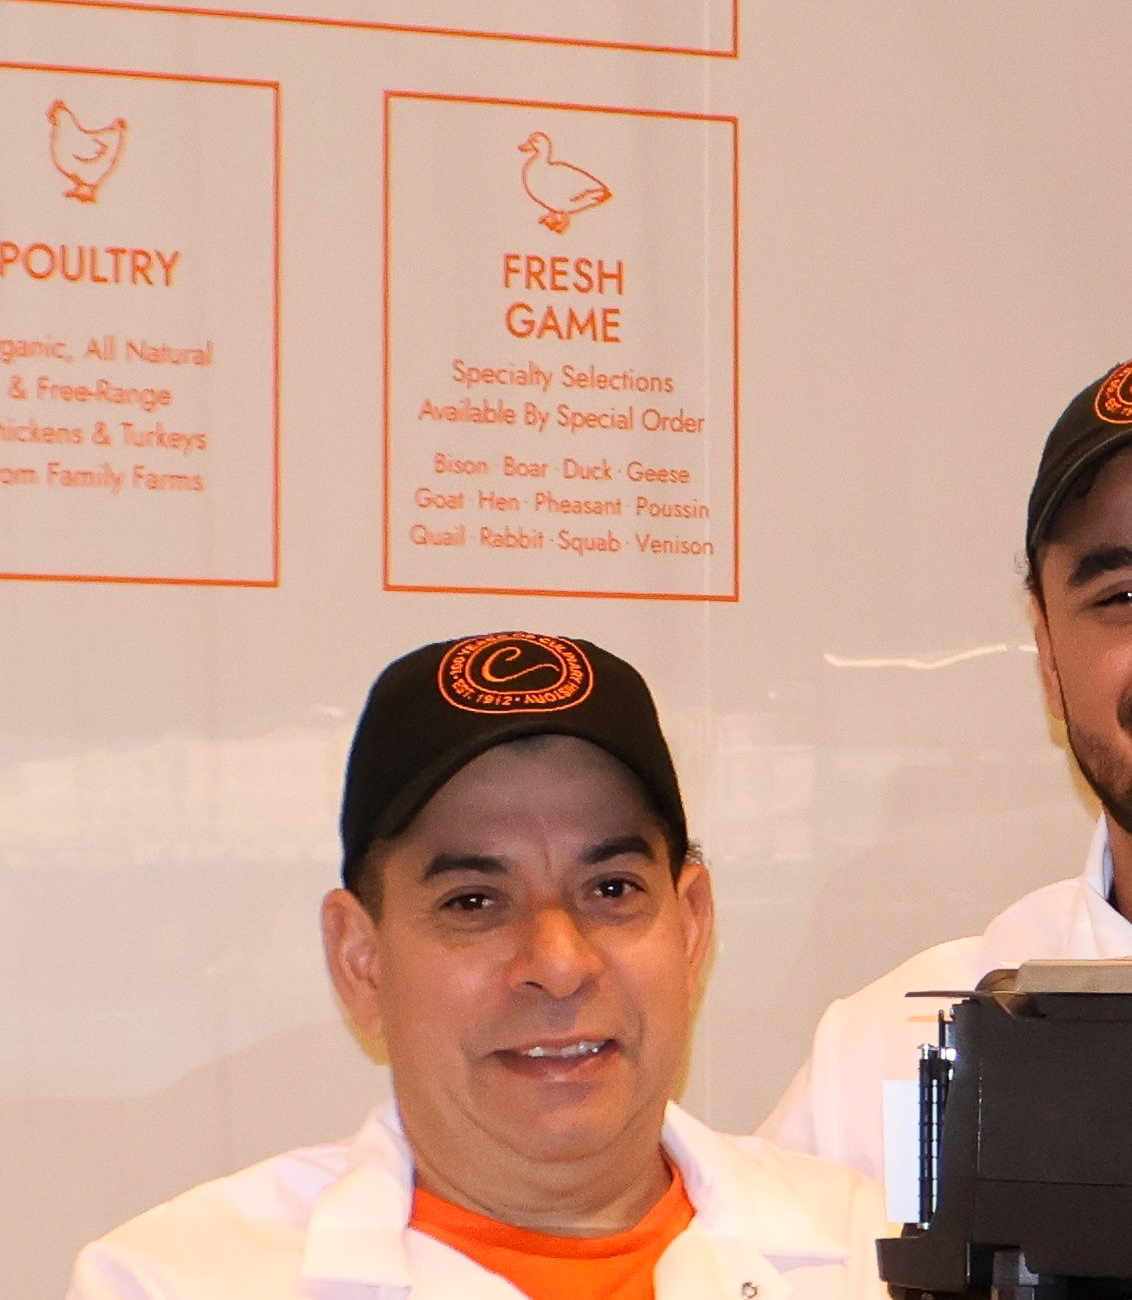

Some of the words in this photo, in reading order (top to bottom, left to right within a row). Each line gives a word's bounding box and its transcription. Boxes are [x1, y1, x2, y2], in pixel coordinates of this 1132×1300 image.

[0, 241, 181, 287] POULTRY
[503, 254, 625, 295] FRESH
[505, 302, 621, 343] GAME
[85, 335, 116, 361] All
[126, 336, 213, 367] Natural
[452, 359, 552, 391] Specialty
[562, 364, 674, 393] Selections
[8, 375, 28, 400] &
[37, 376, 174, 413] Free-Range
[418, 397, 517, 425] Available
[524, 401, 549, 432] By
[557, 404, 633, 432] Special
[642, 407, 705, 433] Order
[92, 421, 112, 446] &
[121, 421, 208, 455] Turkeys
[46, 461, 125, 494] Family
[133, 464, 204, 491] Farms
[434, 452, 488, 475] Bison
[503, 456, 549, 478] Boar
[563, 457, 613, 481] Duck
[627, 462, 691, 484] Geese
[415, 487, 464, 509] Goat
[478, 490, 520, 512] Hen
[535, 490, 621, 516] Pheasant
[636, 496, 710, 520] Poussin
[410, 524, 465, 547] Quail
[480, 526, 544, 550] Rabbit
[558, 529, 621, 556] Squab
[636, 533, 714, 556] Venison
